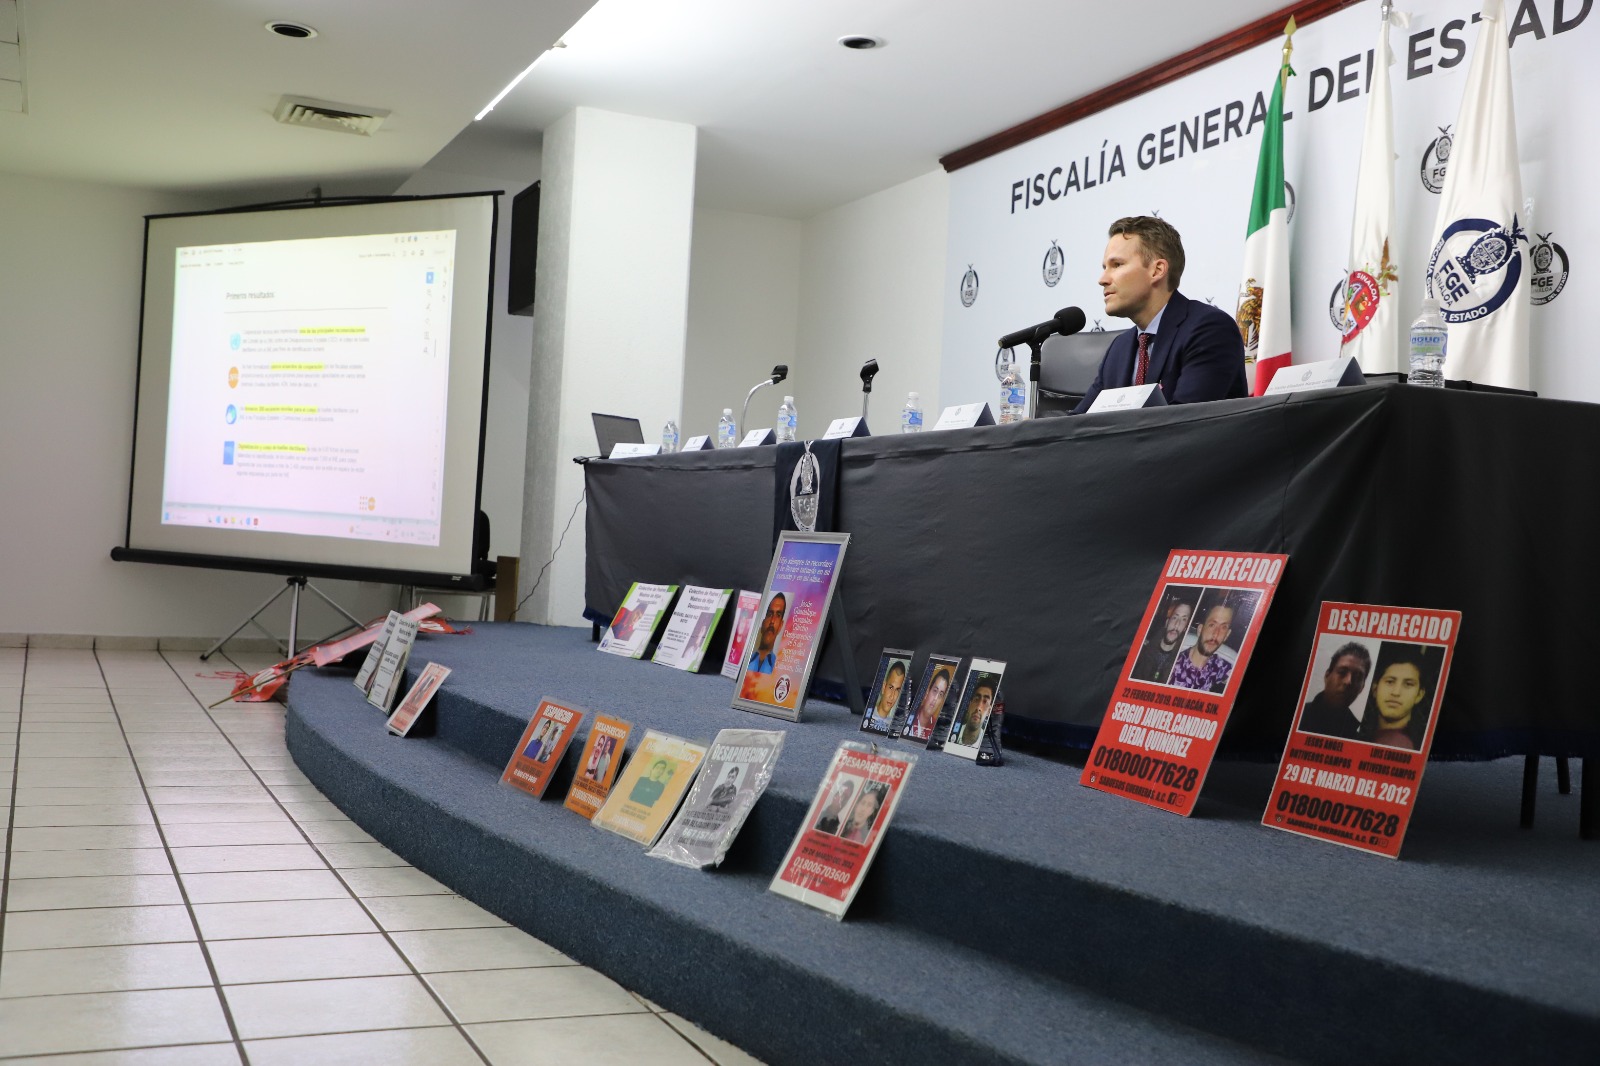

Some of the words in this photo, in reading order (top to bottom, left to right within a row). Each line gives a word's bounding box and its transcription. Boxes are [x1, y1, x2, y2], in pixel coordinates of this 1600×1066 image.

[1011, 139, 1126, 214] FISCALÍA
[1356, 272, 1379, 302] SINALOA
[1439, 259, 1470, 302] FGE
[1448, 306, 1488, 322] ESTADO
[798, 498, 815, 512] FGE
[1166, 555, 1282, 584] DESAPARECIDO
[1328, 608, 1453, 641] DESAPARECIDO
[1122, 688, 1131, 698] 22
[1130, 689, 1156, 702] FEBRERO
[1112, 702, 1144, 725] SERGIO
[1141, 708, 1174, 733] JAVIER
[1171, 713, 1218, 741] CANDIDO
[1118, 724, 1147, 748] OJEDA
[711, 745, 769, 763] DESAPARECIDO
[842, 756, 903, 778] DESAPARECIDOS
[1324, 754, 1352, 769] CAMPOS
[1093, 746, 1199, 792] 01800077628
[1390, 767, 1416, 780] CAMPOS
[1283, 763, 1300, 781] 29
[1300, 767, 1316, 785] DE
[1315, 770, 1355, 793] MARZO
[1355, 778, 1377, 799] DEL
[1378, 783, 1411, 806] 2012
[1276, 790, 1400, 837] 01800077628
